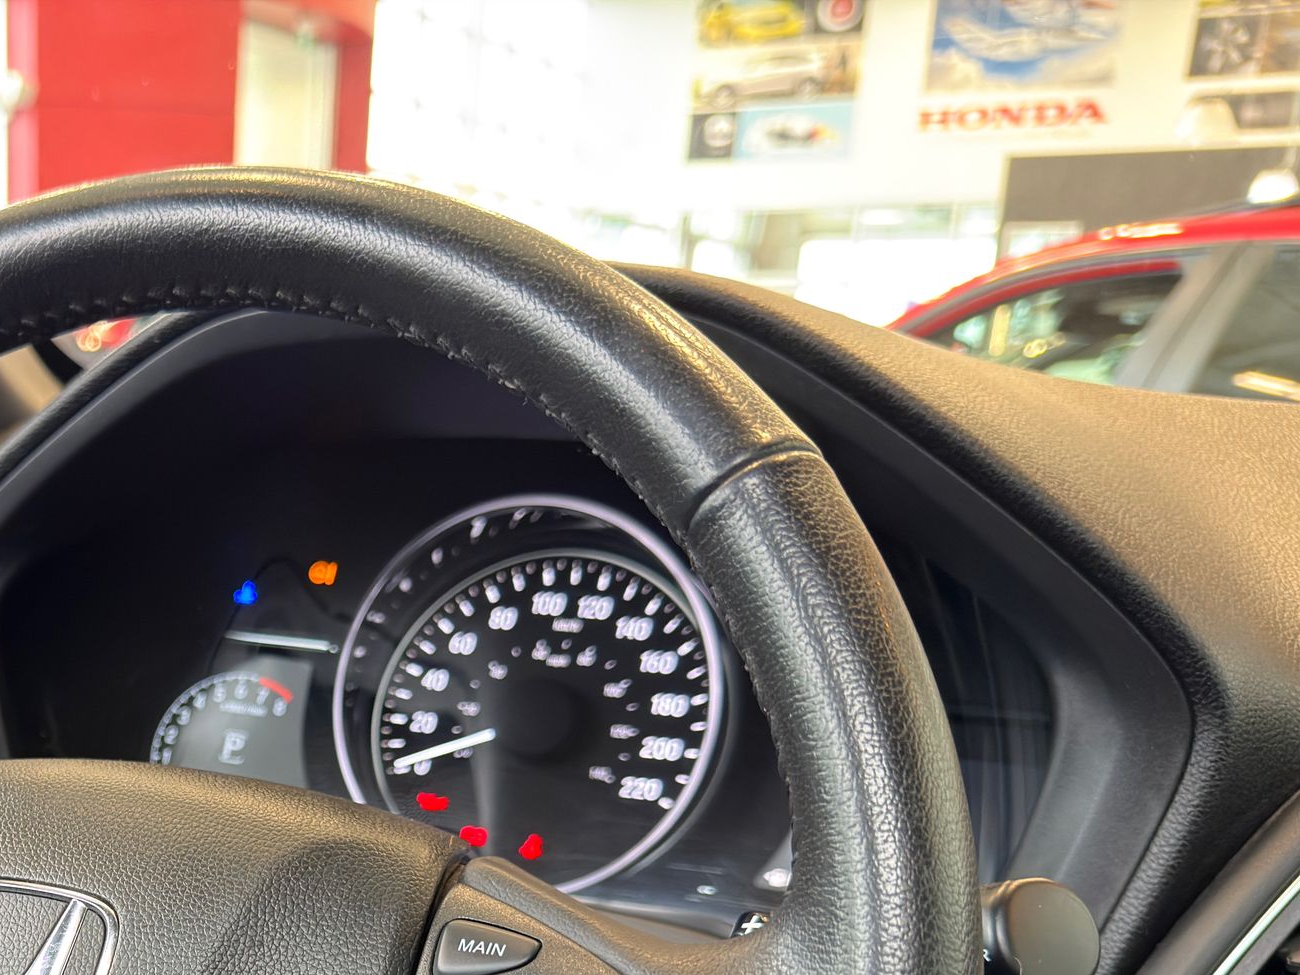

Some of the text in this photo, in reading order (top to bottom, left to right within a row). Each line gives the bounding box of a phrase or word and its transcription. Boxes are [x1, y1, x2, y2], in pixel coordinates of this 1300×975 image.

[919, 98, 1108, 133] HONDA
[531, 591, 568, 617] 100
[577, 594, 615, 621] 120
[488, 606, 518, 631] 80
[615, 615, 654, 641] 140
[448, 631, 477, 655] 60
[639, 649, 680, 675] 160
[420, 668, 449, 692] 40
[650, 692, 690, 718] 180
[409, 711, 438, 734] 20
[638, 736, 685, 762] 200
[618, 776, 663, 802] 220
[457, 937, 507, 958] MAIN
